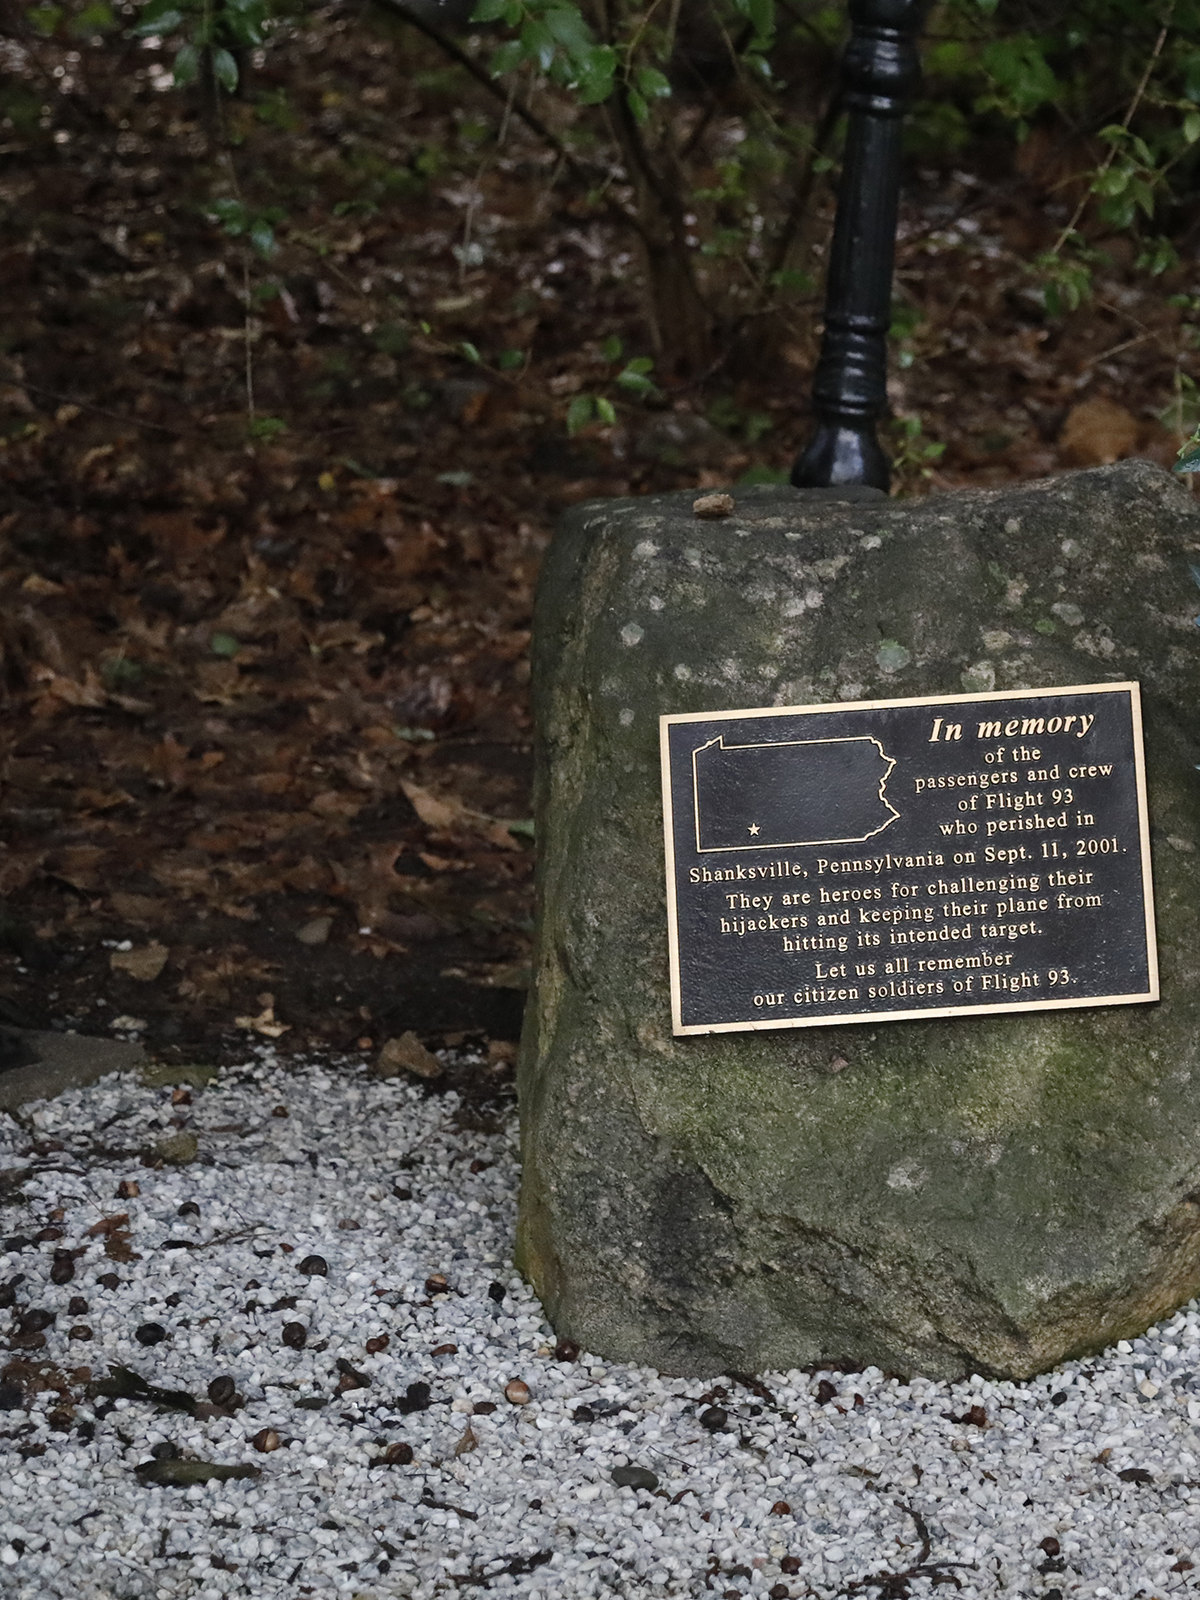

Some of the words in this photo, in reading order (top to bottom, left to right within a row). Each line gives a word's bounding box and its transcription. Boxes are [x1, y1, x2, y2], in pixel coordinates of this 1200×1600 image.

[928, 717, 963, 743] In
[977, 713, 1095, 739] memory
[984, 746, 1006, 764] of
[1011, 745, 1041, 762] the
[914, 771, 1018, 793] passengers
[1027, 764, 1060, 782] and
[1068, 764, 1113, 779] crew
[957, 794, 979, 811] of
[985, 790, 1044, 811] Flight
[1051, 788, 1074, 805] 93
[939, 819, 978, 836] who
[986, 812, 1068, 836] perished
[1076, 810, 1095, 826] in
[689, 860, 808, 883] Shanksville,
[816, 851, 945, 875] Pennsylvania
[953, 850, 976, 865] on
[984, 846, 1033, 865] Sept.
[1041, 841, 1068, 860] 11,
[1076, 837, 1127, 856] 2001.
[725, 893, 773, 911] They
[782, 892, 811, 906] are
[819, 887, 882, 903] heroes
[890, 882, 919, 898] for
[927, 874, 1040, 897] challenging
[1047, 868, 1094, 887] their
[719, 913, 808, 936] hijackers
[817, 908, 851, 927] and
[858, 904, 935, 925] keeping
[942, 899, 989, 917] their
[996, 897, 1048, 918] plane
[1056, 893, 1102, 909] from
[782, 934, 849, 955] hitting
[857, 930, 881, 947] its
[889, 923, 972, 944] intended
[980, 920, 1043, 940] target.
[814, 962, 847, 980] Let
[854, 963, 876, 977] us
[884, 956, 909, 974] all
[917, 951, 1013, 972] remember
[753, 991, 785, 1007] our
[793, 985, 860, 1004] citizen
[868, 979, 944, 999] soldiers
[952, 976, 974, 993] of
[980, 971, 1040, 992] Flight
[1048, 967, 1079, 986] 93.
